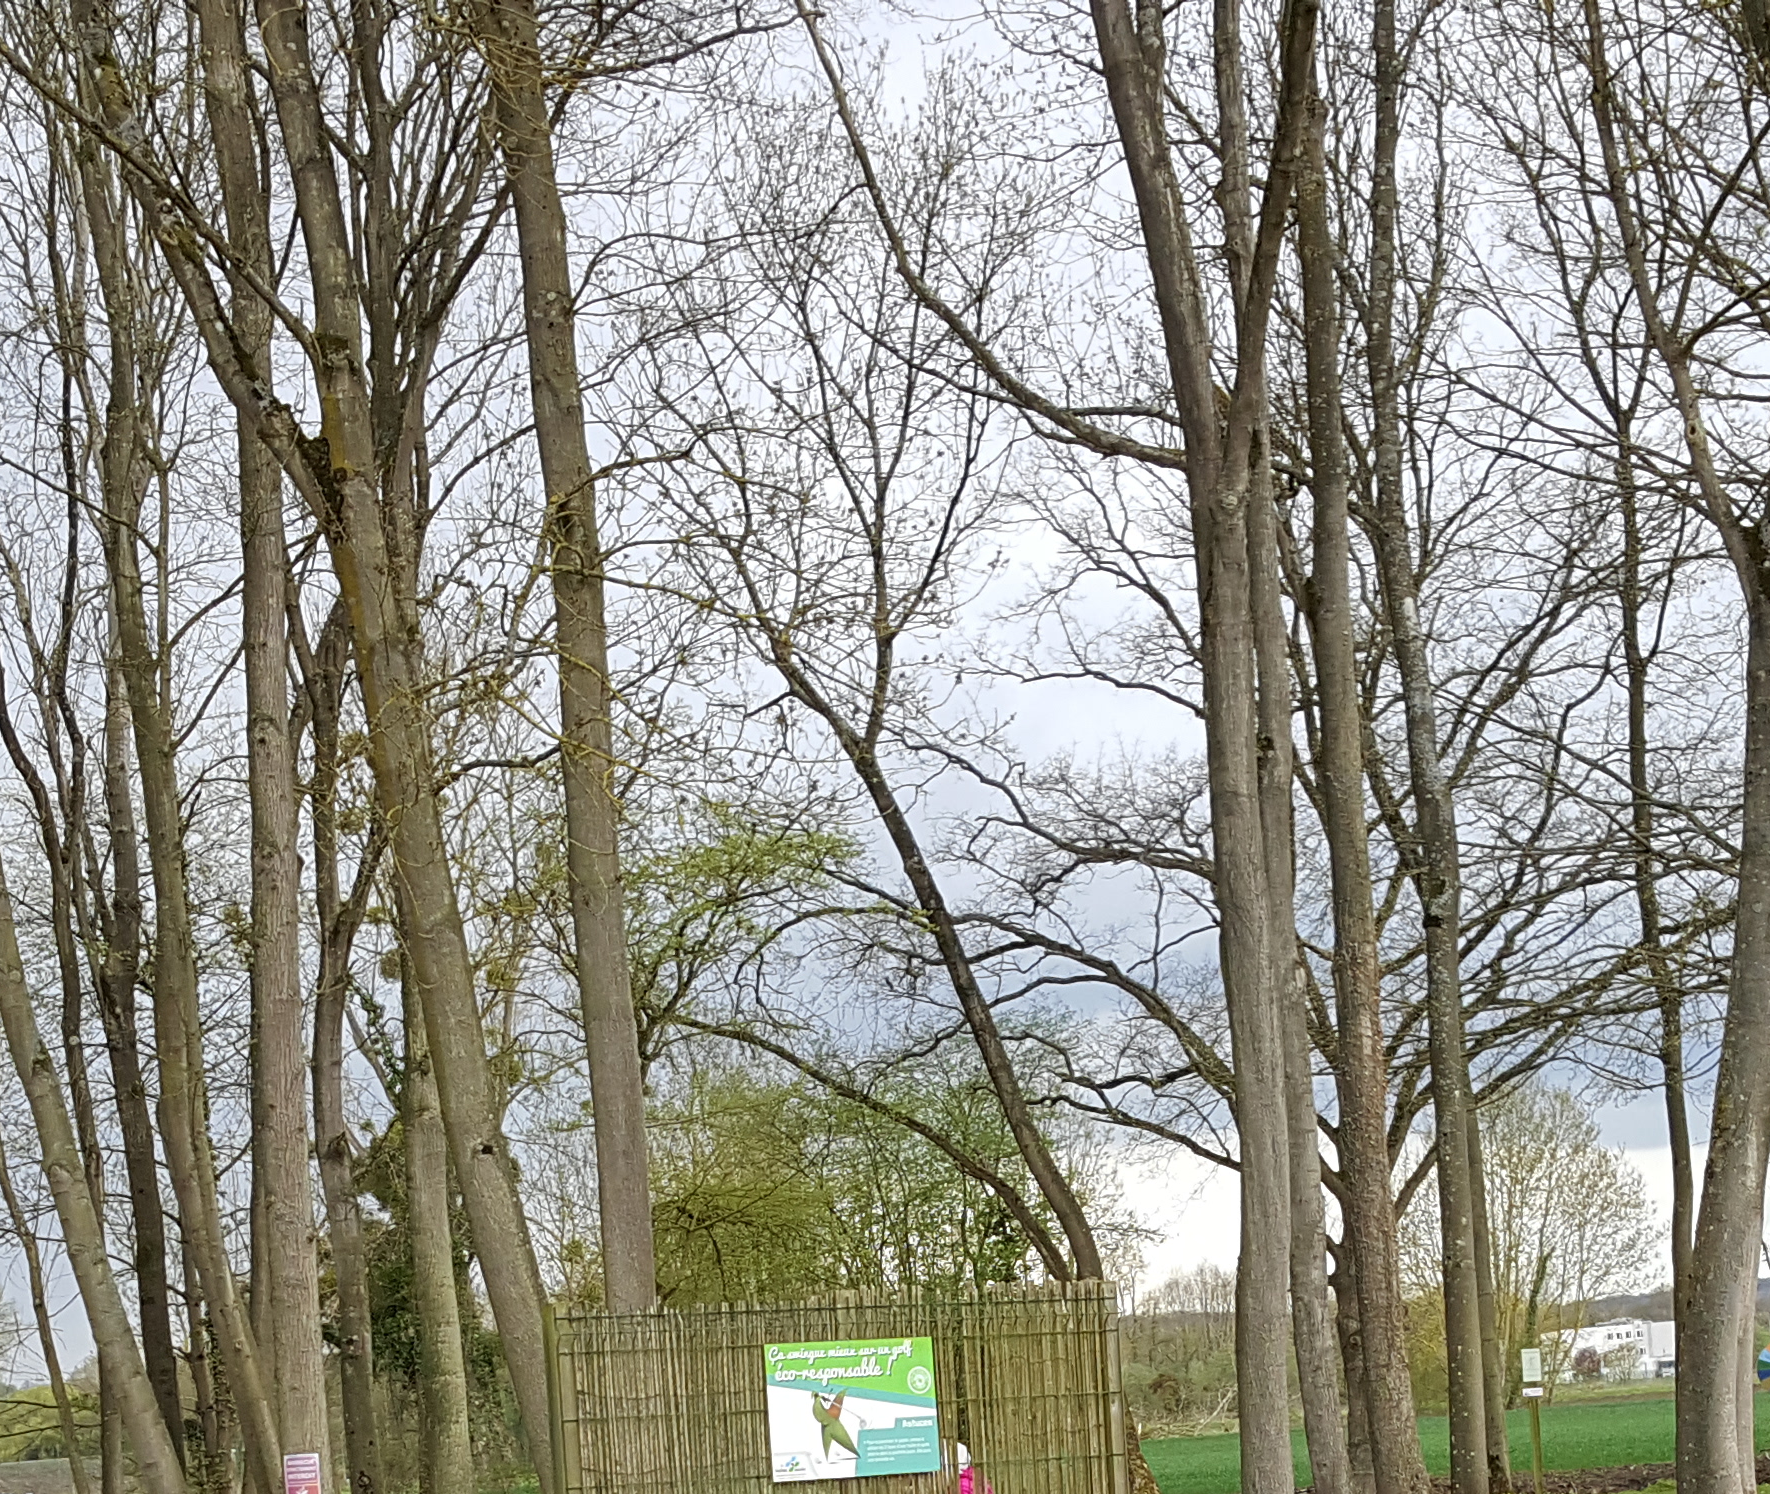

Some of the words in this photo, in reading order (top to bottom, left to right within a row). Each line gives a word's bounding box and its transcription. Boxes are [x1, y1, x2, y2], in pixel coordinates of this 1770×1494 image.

[769, 1346, 786, 1366] Ça
[892, 1339, 913, 1361] golf
[775, 1356, 883, 1387] éco-responsable
